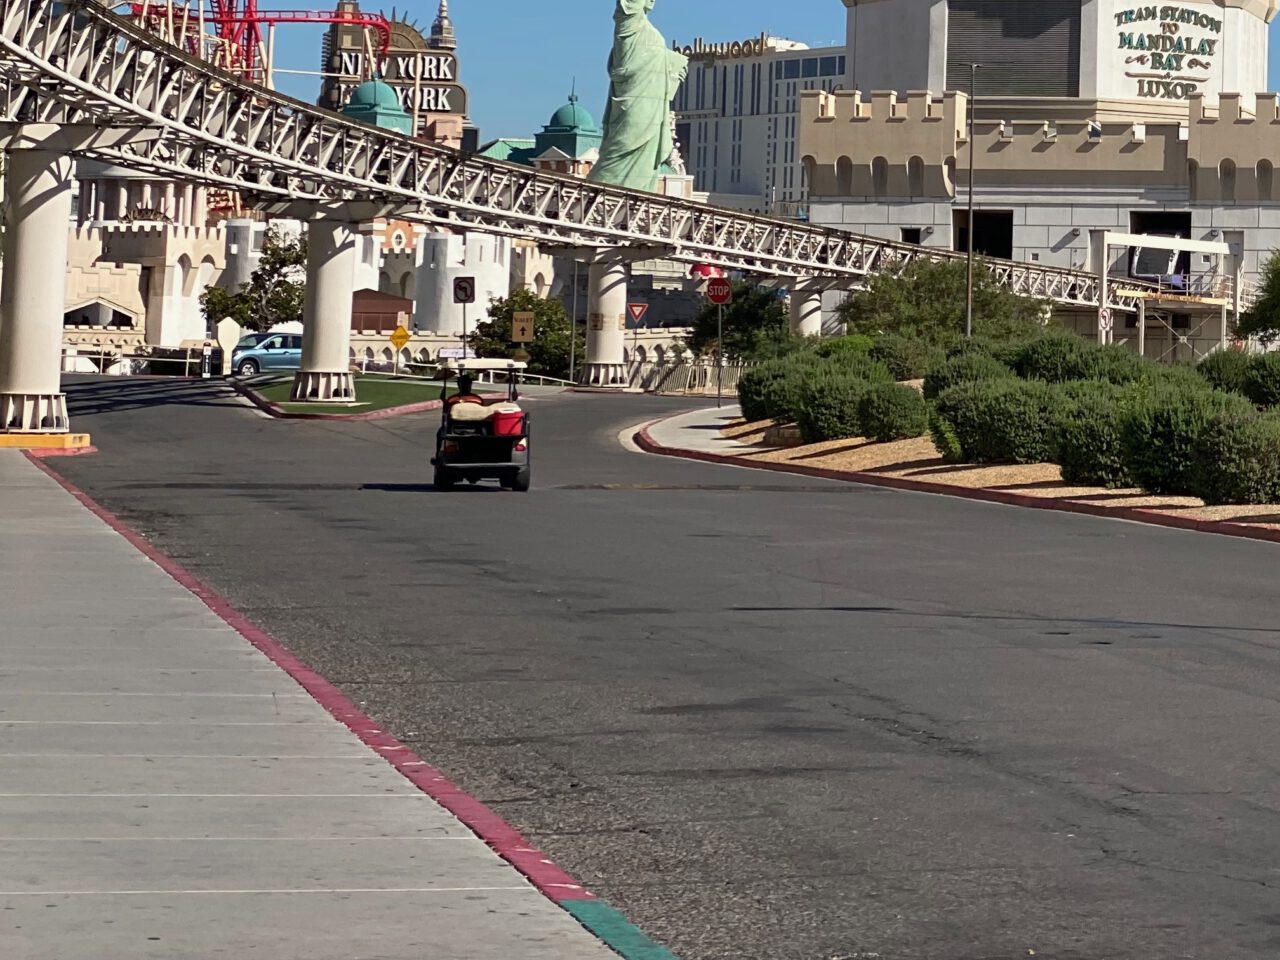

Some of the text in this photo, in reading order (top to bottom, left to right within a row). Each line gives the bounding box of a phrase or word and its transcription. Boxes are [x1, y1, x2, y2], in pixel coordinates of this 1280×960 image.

[1114, 5, 1222, 34] TRAM STATION
[1160, 21, 1180, 35] TO
[672, 31, 765, 68] hollywood
[1118, 32, 1219, 56] MANDALAY
[397, 55, 453, 80] YORK
[1150, 51, 1186, 71] BAY
[395, 85, 452, 112] YORK
[708, 285, 730, 296] STOP
